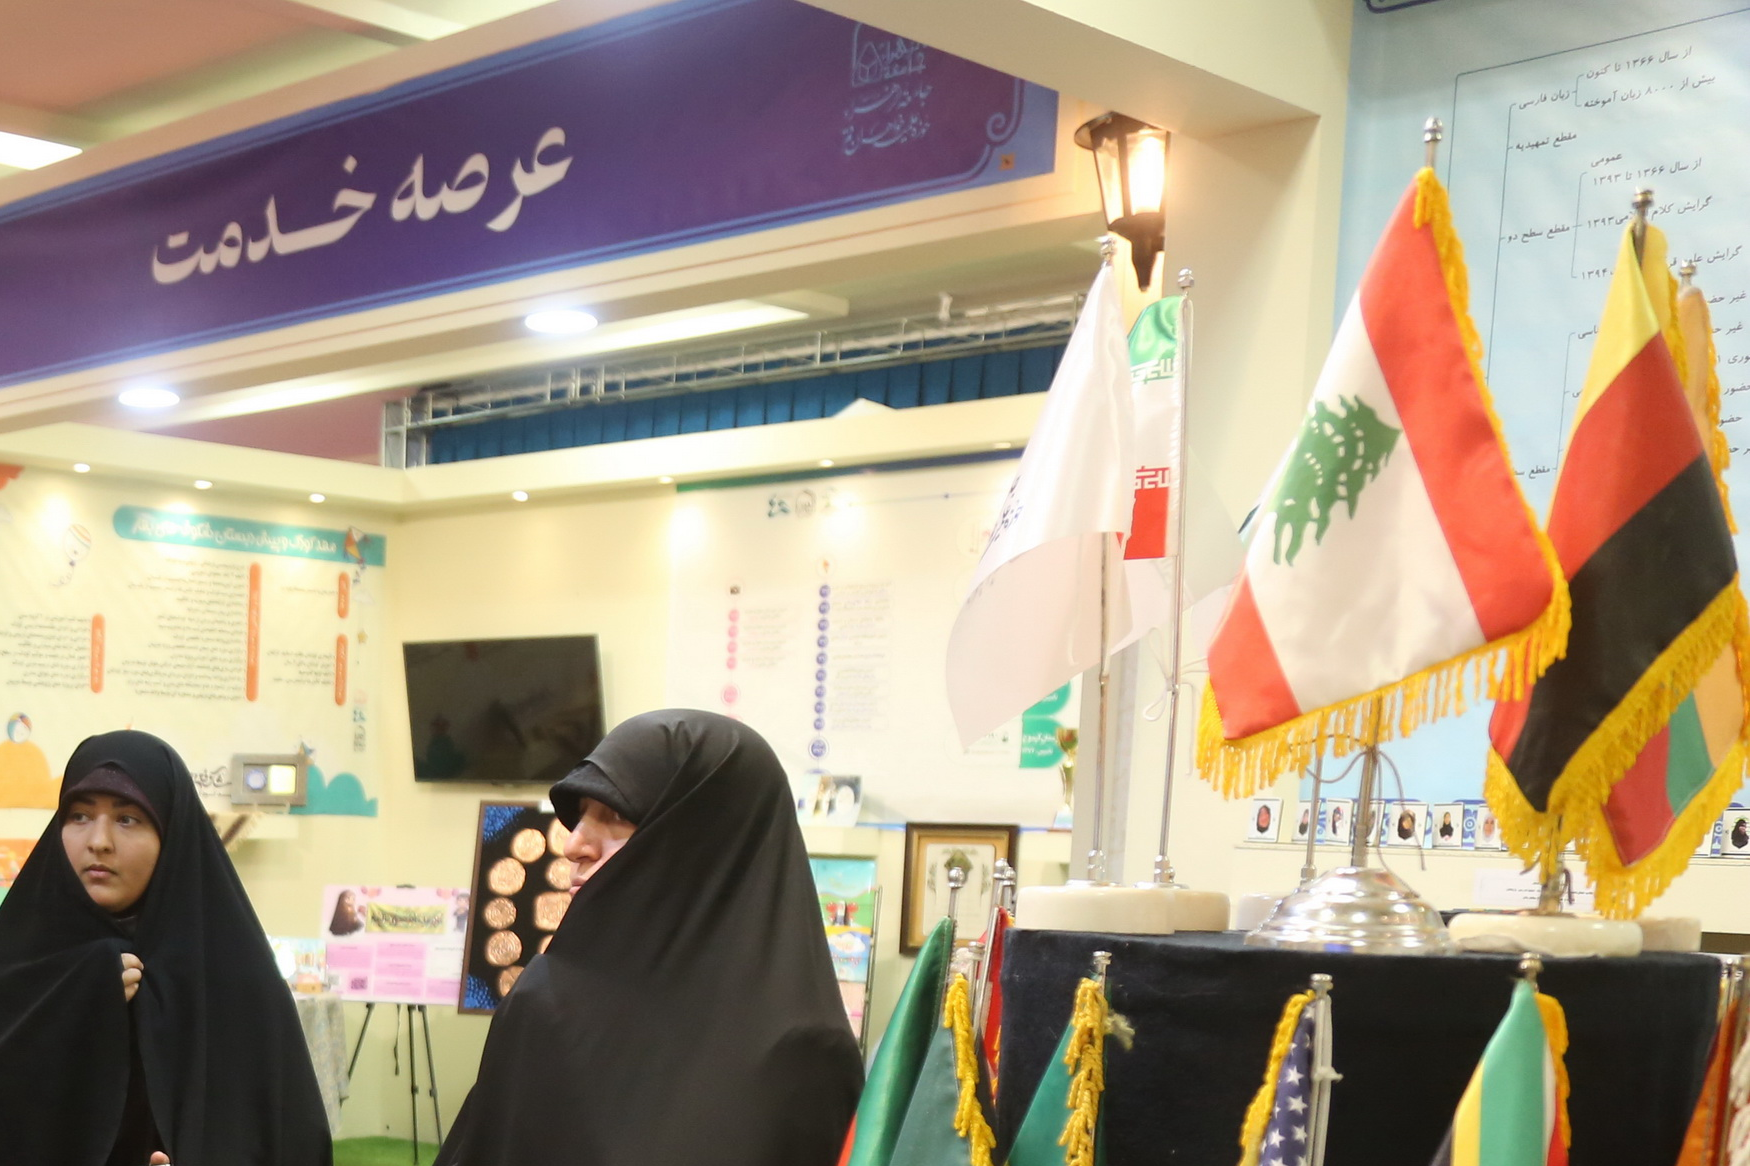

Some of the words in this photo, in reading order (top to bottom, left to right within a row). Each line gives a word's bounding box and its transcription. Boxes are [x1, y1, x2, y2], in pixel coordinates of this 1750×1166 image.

[1658, 50, 1679, 64] سال
[1682, 45, 1693, 59] از
[1614, 59, 1621, 73] تا
[1625, 55, 1654, 71] ۱۳۶۶
[1585, 64, 1611, 80] کنون
[1678, 77, 1690, 91] از
[1691, 73, 1717, 89] بیش
[1518, 92, 1548, 111] فارسی
[1550, 89, 1570, 103] زبان
[1583, 90, 1618, 109] آموخته
[1620, 89, 1641, 102] زبان
[1515, 136, 1550, 151] تمهیدیه
[1552, 131, 1578, 148] مقطع
[1590, 152, 1623, 169] عمومی
[1669, 161, 1689, 175] سال
[1691, 157, 1702, 171] از
[388, 126, 575, 234] عرصه
[1593, 173, 1621, 187] ۱۳۹۳
[1625, 169, 1632, 182] تا
[1637, 165, 1666, 180] ۱۳۶۶
[1650, 202, 1675, 219] کلام
[1677, 195, 1713, 215] گرایش
[151, 154, 378, 286] خدمت
[1505, 232, 1518, 244] دو
[1521, 228, 1544, 244] سطح
[1546, 224, 1571, 240] مقطع
[1706, 245, 1744, 265] گرایش
[1728, 291, 1748, 305] غیر
[1725, 320, 1744, 336] غیر
[1528, 464, 1551, 479] مقطع
